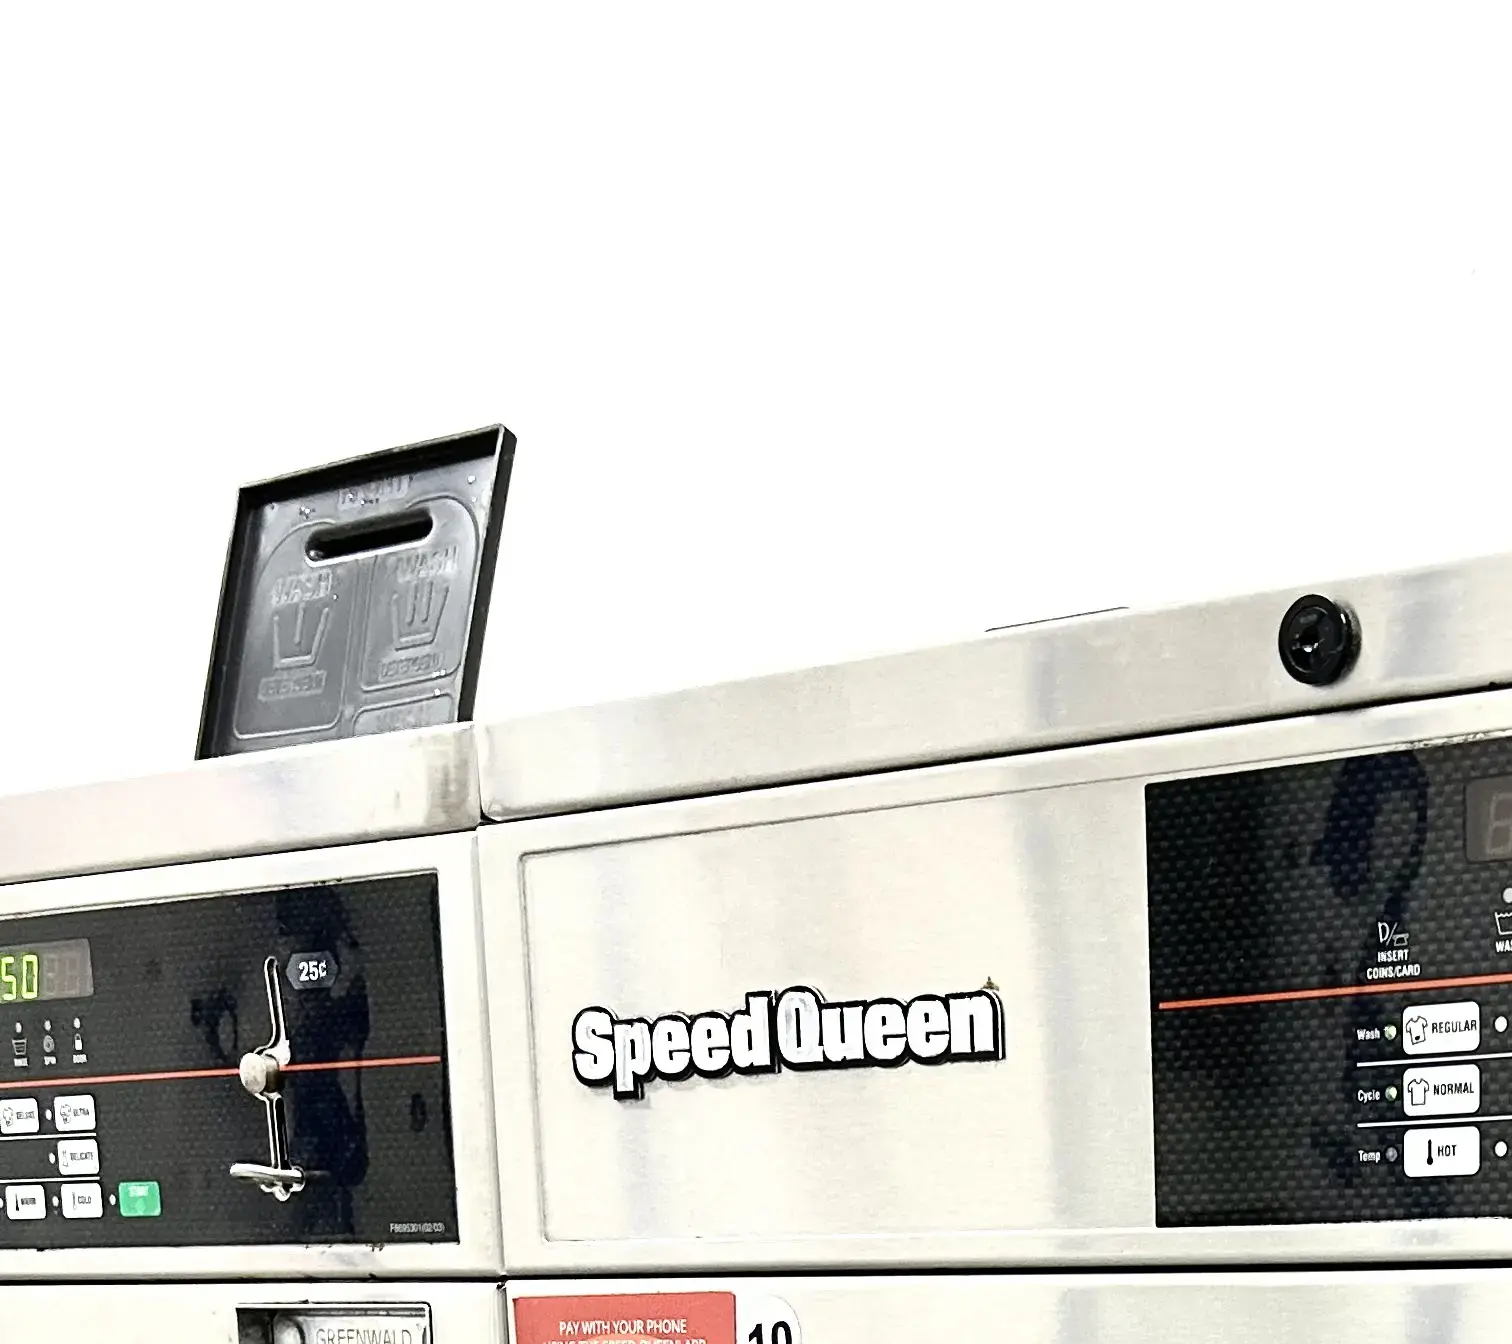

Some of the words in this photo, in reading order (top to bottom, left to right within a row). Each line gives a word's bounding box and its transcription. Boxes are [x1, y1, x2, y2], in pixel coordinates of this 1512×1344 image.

[1377, 950, 1410, 963] INSERT
[1366, 964, 1421, 980] COINS/CARD
[1356, 1028, 1381, 1041] Wash
[1431, 1020, 1478, 1034] REGULAR
[1357, 1088, 1381, 1103] Cycle
[1433, 1081, 1475, 1096] NORMAL
[1357, 1149, 1381, 1164] Temp
[1437, 1145, 1457, 1158] HOT
[559, 1321, 580, 1335] PAY
[581, 1321, 611, 1335] WITH
[612, 1320, 645, 1335] YOUR
[646, 1319, 687, 1334] PHONE
